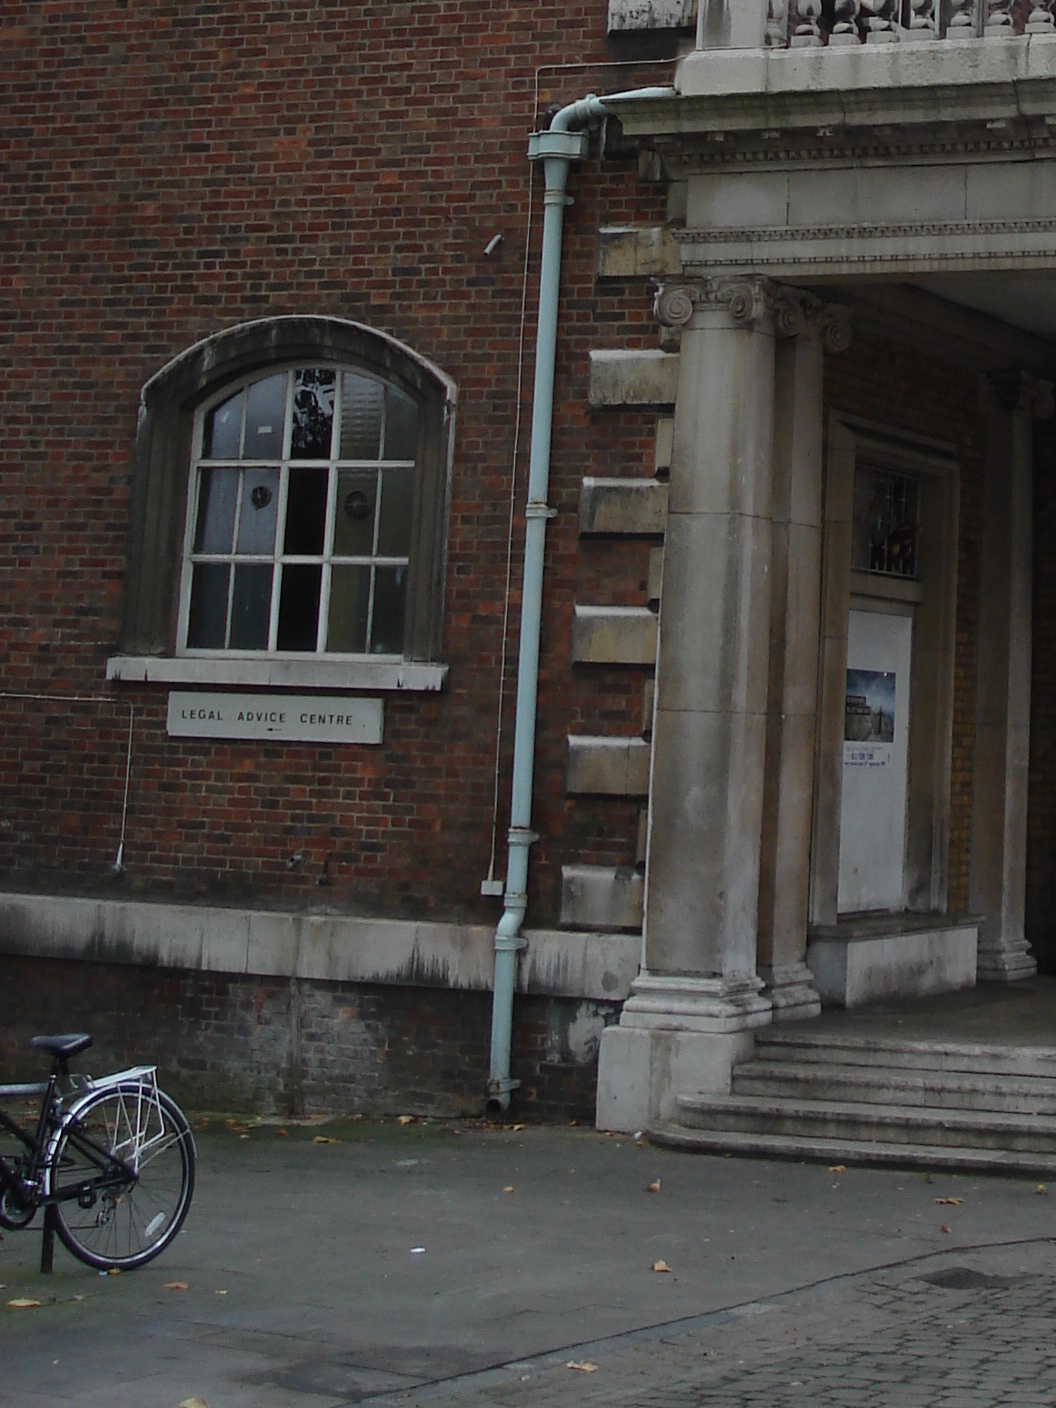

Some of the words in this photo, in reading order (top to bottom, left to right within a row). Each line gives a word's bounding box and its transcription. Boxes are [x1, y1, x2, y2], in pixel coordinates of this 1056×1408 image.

[181, 709, 224, 721] LEGAL
[237, 711, 286, 723] ADVICE
[300, 713, 353, 726] CENTRE
